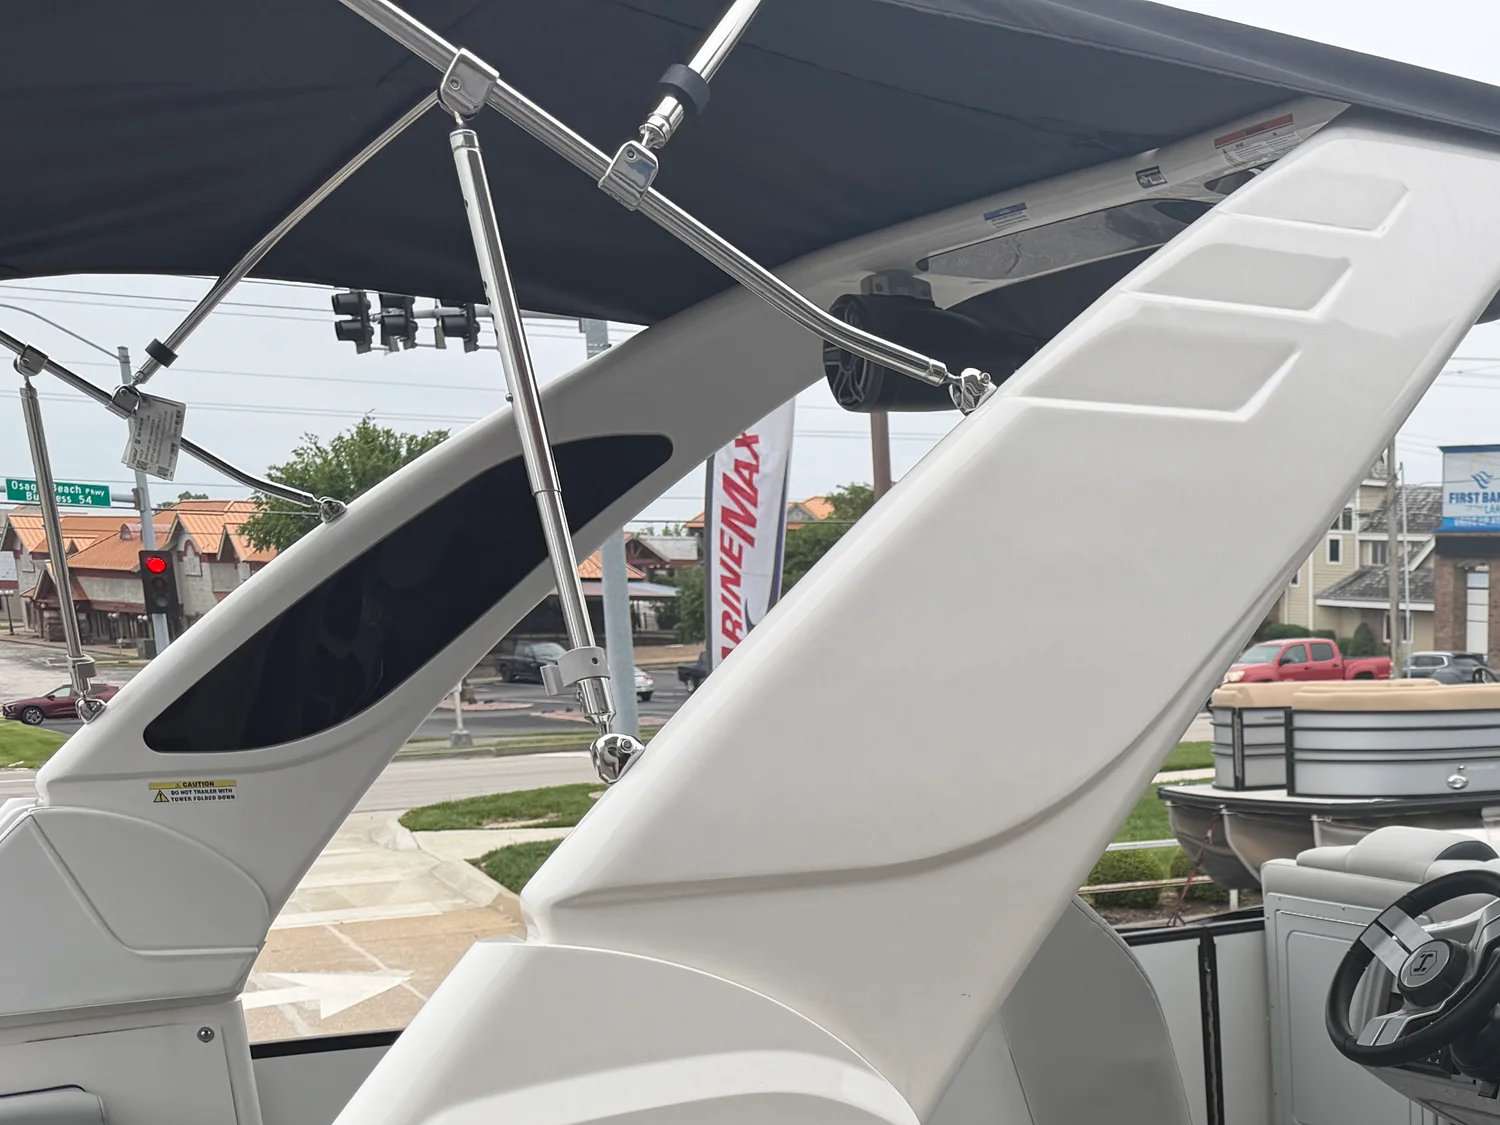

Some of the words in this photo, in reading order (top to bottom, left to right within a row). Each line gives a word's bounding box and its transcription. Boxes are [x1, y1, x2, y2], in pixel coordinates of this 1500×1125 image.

[11, 481, 37, 492] Osag
[79, 495, 92, 504] 54
[1449, 492, 1480, 504] FIRST
